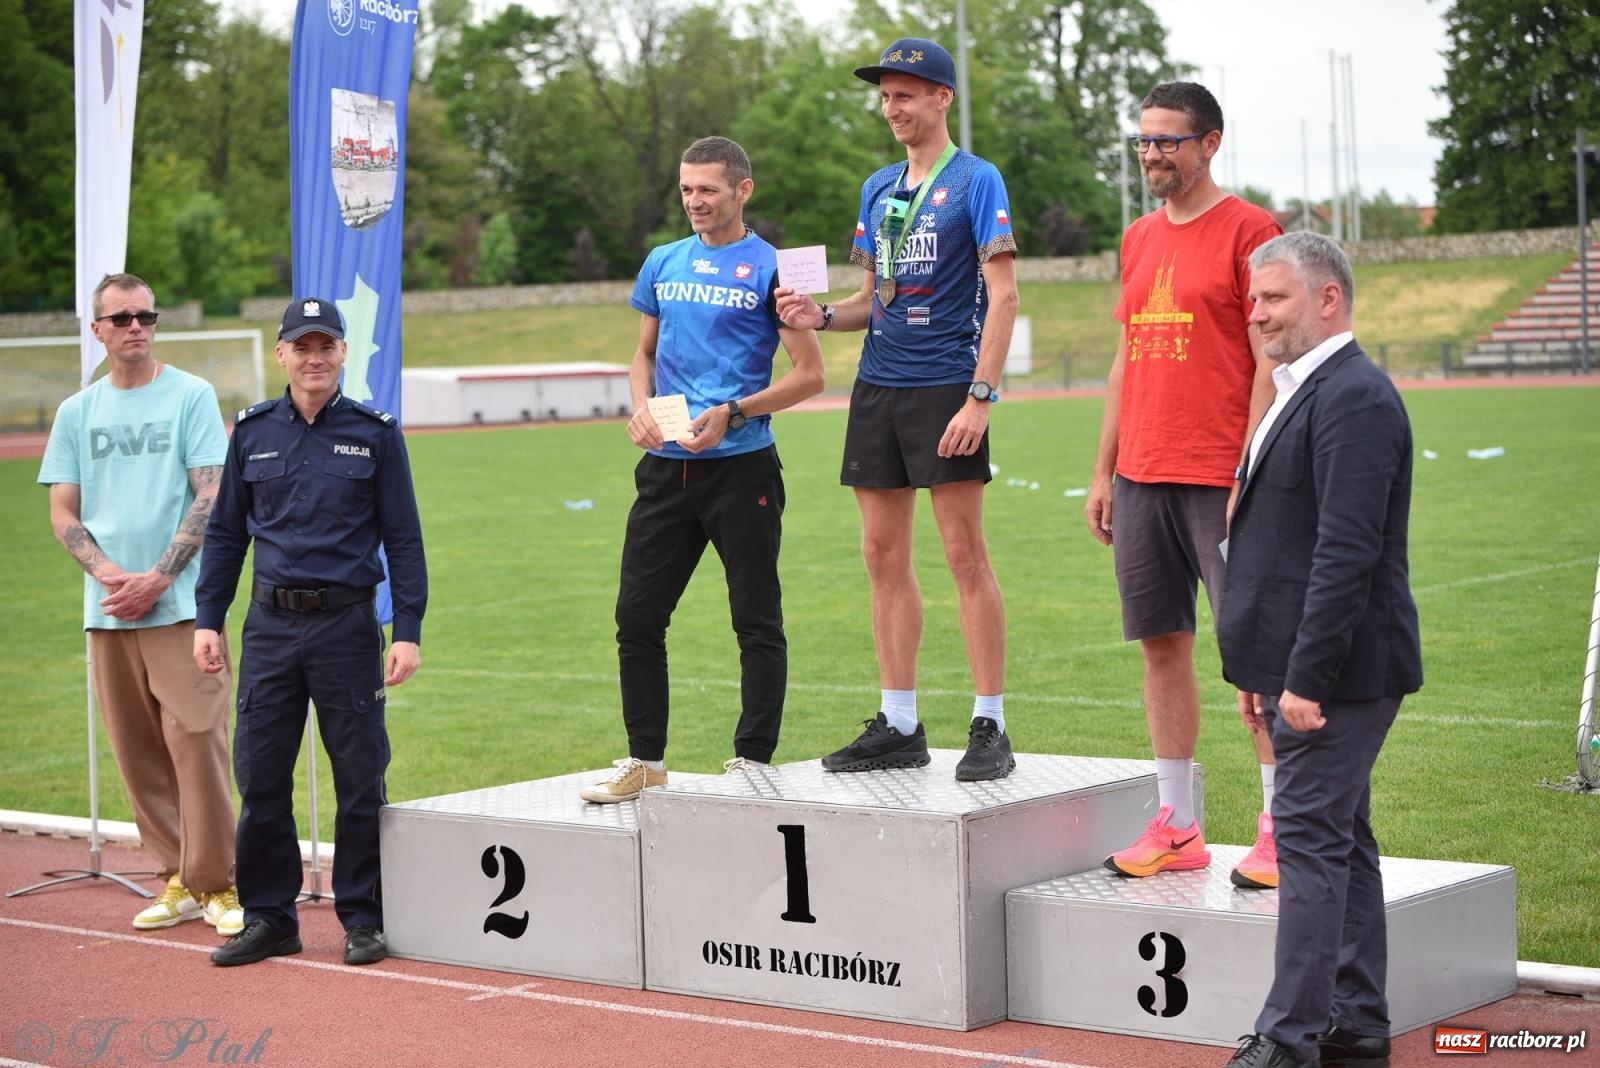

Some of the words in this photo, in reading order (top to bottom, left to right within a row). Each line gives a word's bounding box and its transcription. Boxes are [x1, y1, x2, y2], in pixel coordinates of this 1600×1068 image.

[359, 17, 377, 35] 1217
[909, 262, 933, 276] TEAM
[654, 281, 760, 311] RUNNERS
[89, 421, 172, 461] DAVE
[333, 444, 371, 458] POLICJA
[480, 844, 530, 940] 2
[776, 825, 817, 924] 1
[702, 940, 763, 971] OSIR
[769, 947, 902, 988] RACIBÓRZ
[1136, 931, 1189, 1018] 3
